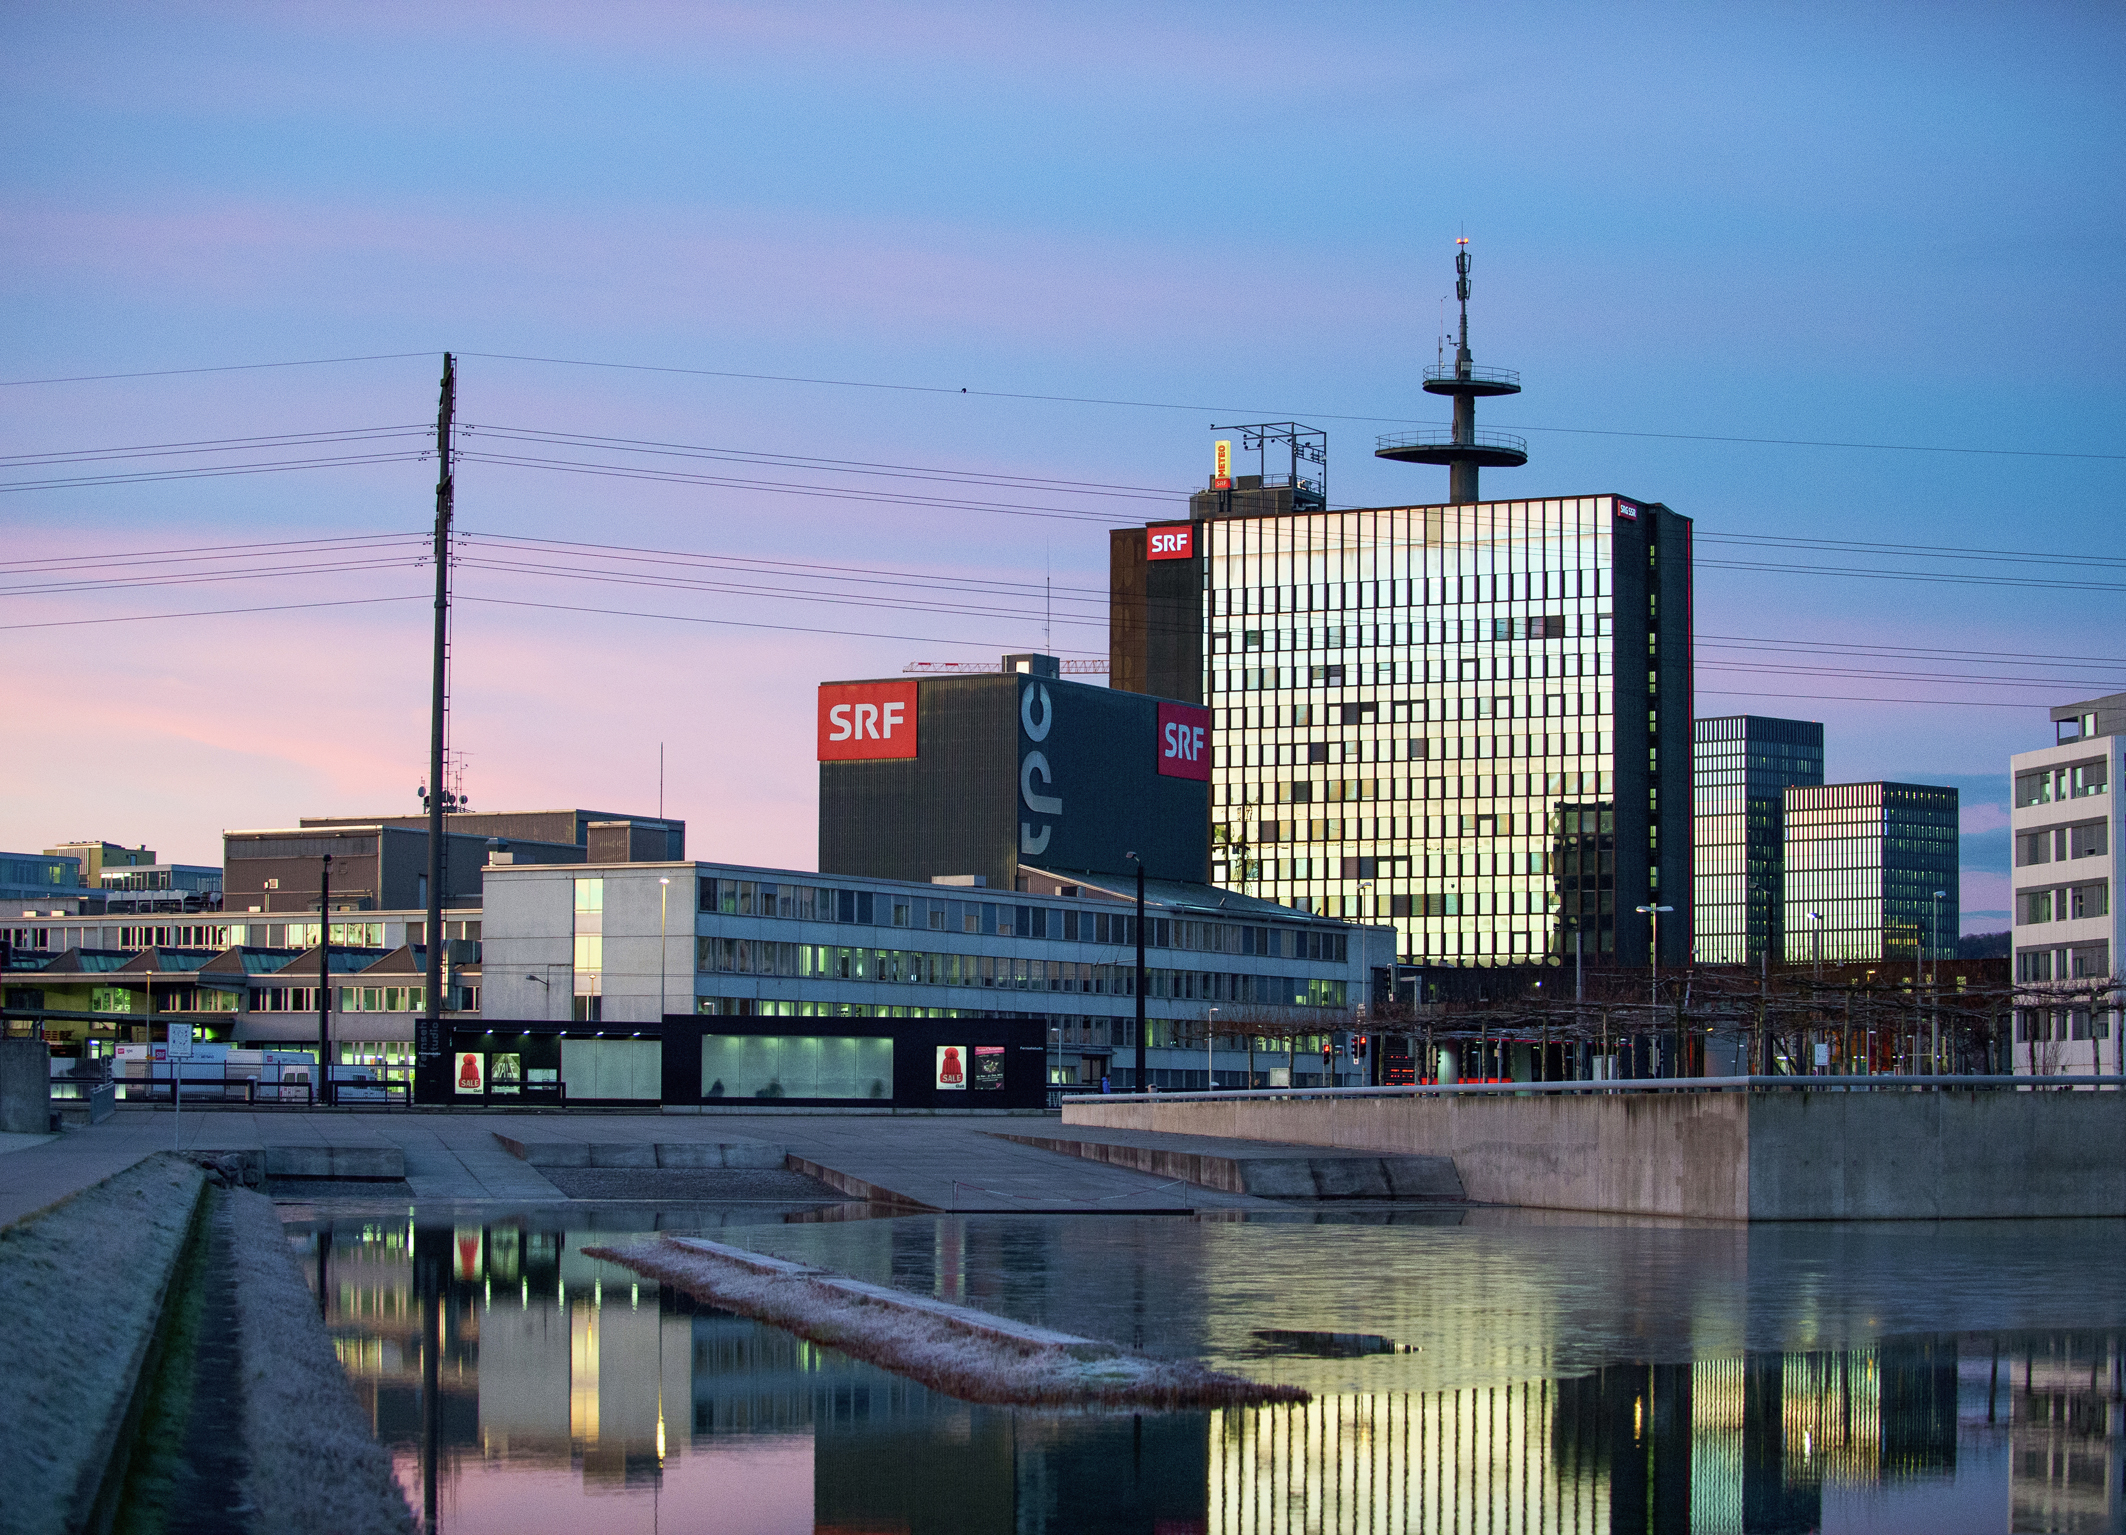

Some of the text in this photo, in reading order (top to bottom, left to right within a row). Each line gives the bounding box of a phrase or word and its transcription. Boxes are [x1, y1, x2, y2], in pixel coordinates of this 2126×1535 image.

[1217, 444, 1226, 477] METEO
[1152, 534, 1188, 553] SRF
[829, 701, 905, 741] SRF
[1164, 722, 1204, 761] SRF
[418, 1022, 427, 1068] Fernseh
[461, 1079, 479, 1087] SALE
[493, 1062, 518, 1079] SALE
[942, 1074, 962, 1083] SALE
